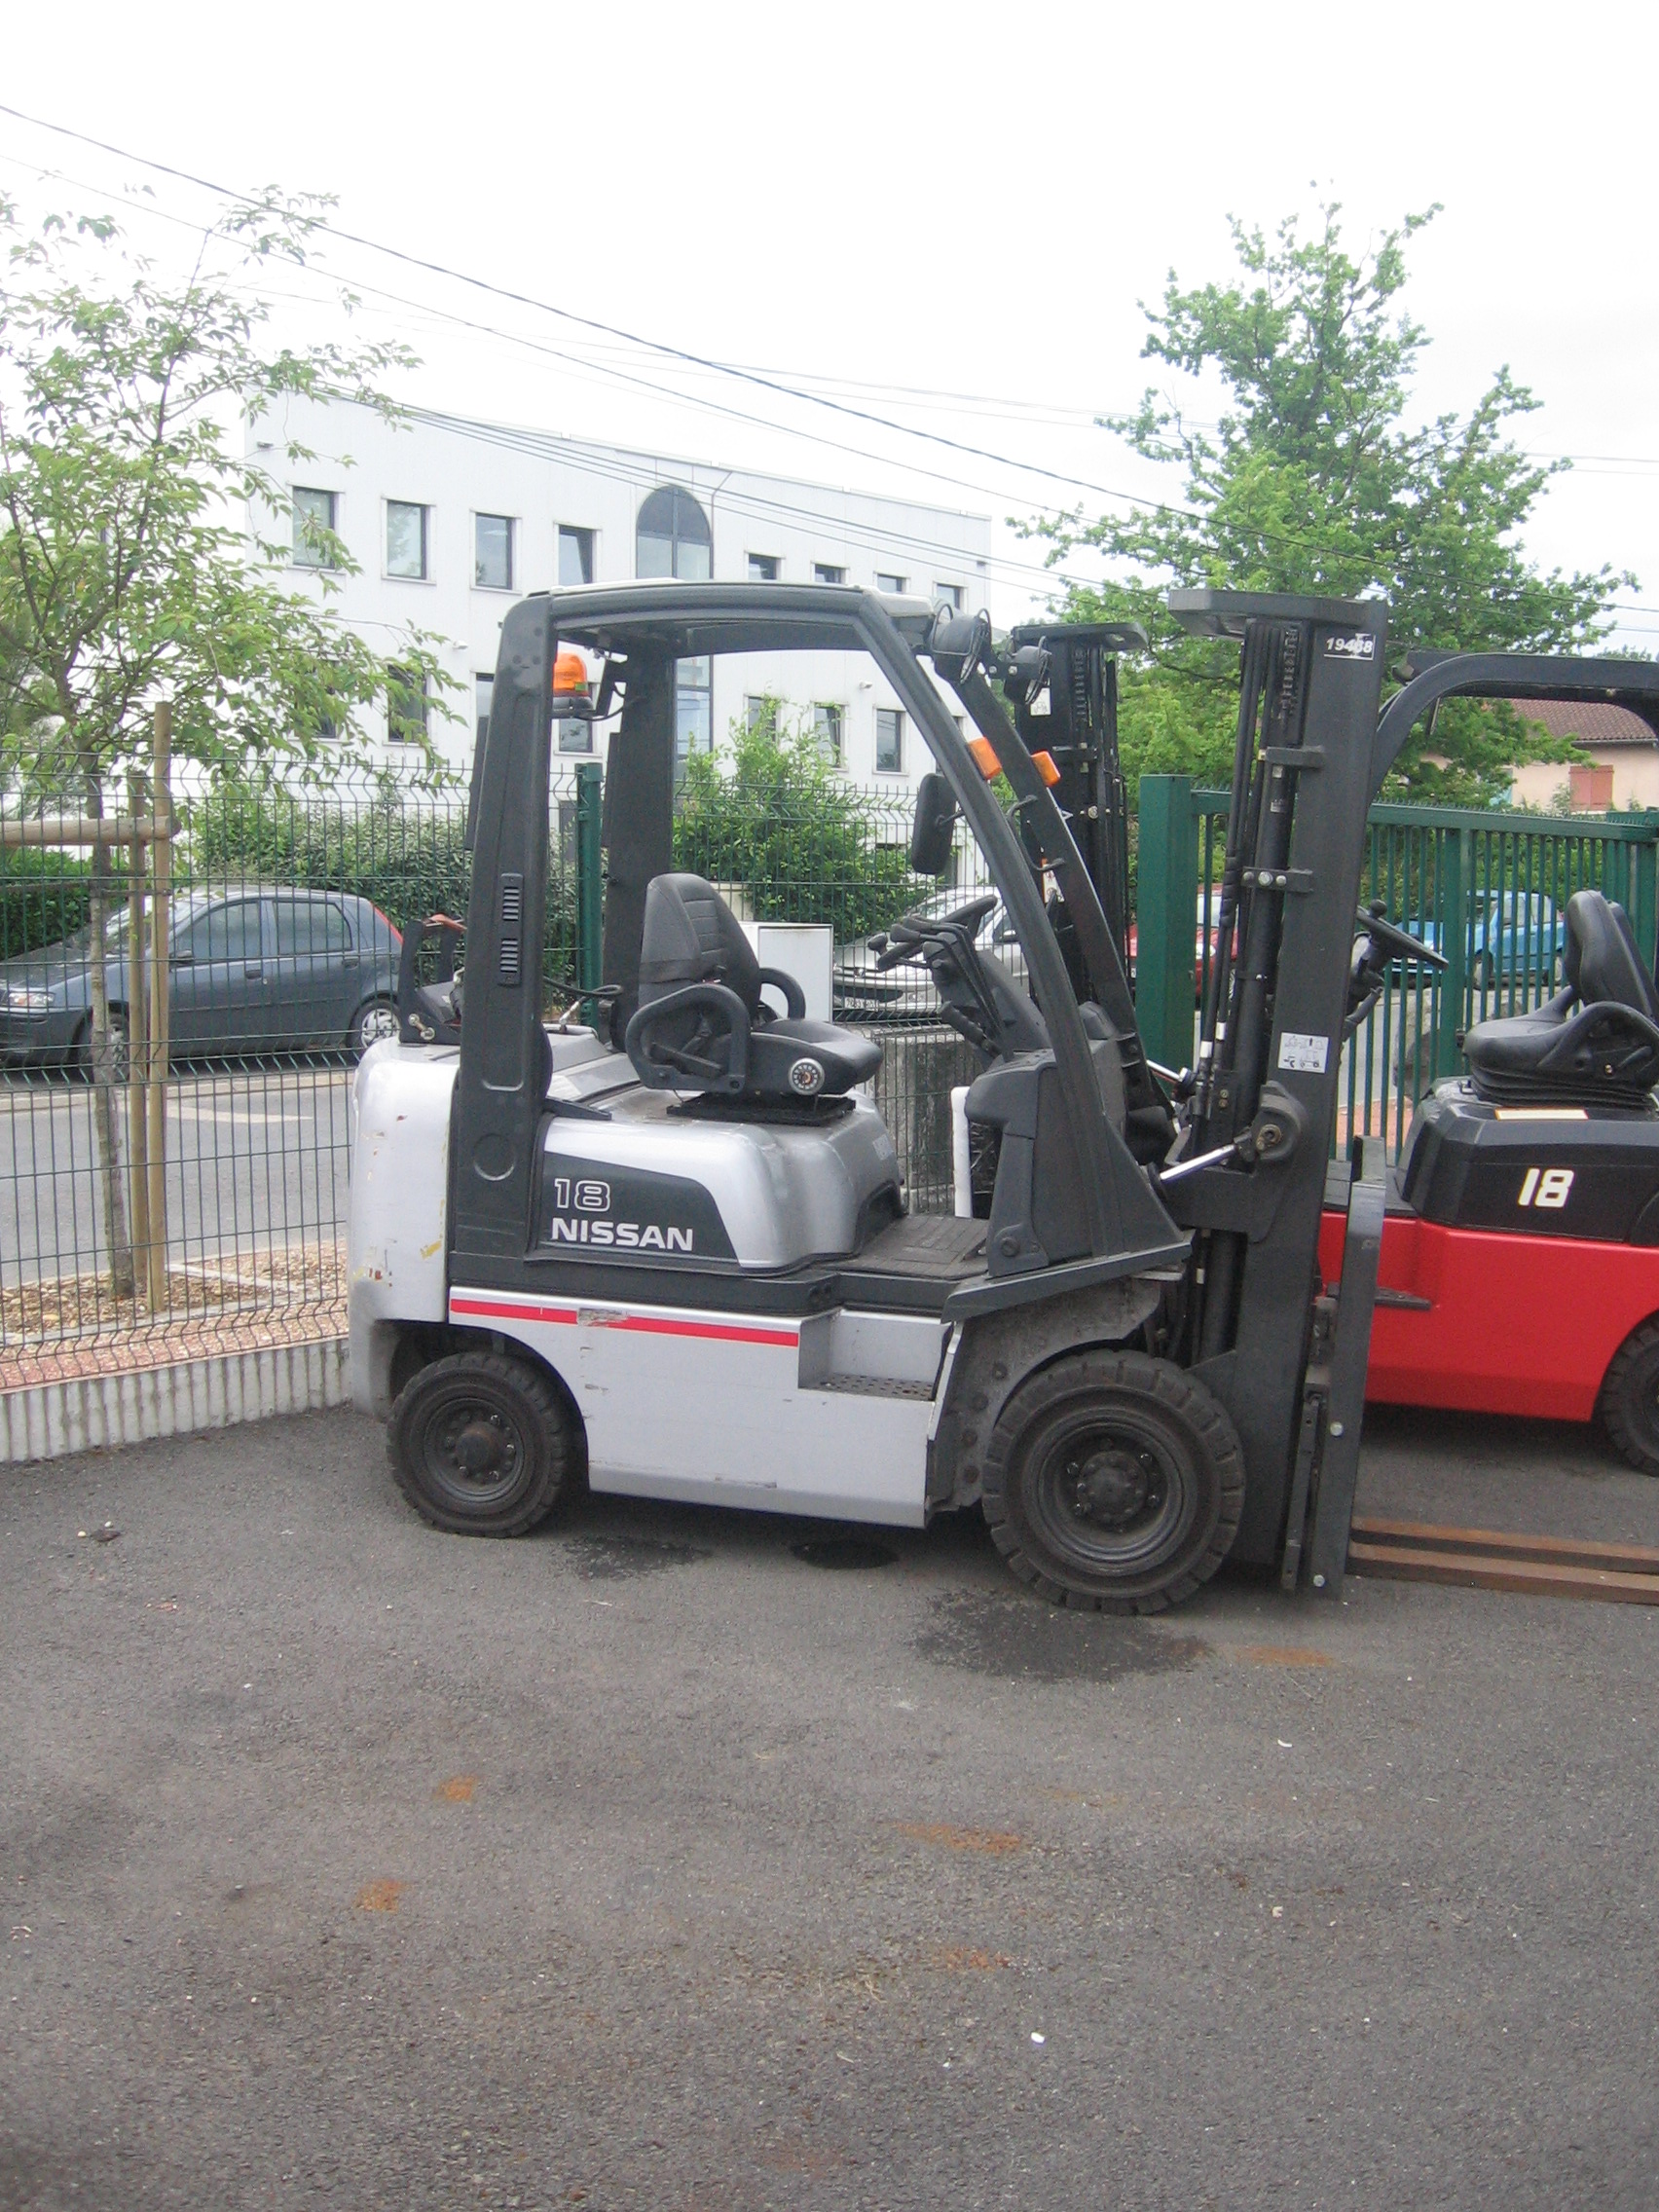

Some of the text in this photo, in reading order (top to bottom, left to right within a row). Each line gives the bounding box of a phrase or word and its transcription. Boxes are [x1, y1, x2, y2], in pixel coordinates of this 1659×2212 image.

[554, 1178, 610, 1212] 18
[1519, 1168, 1574, 1207] 18
[552, 1218, 693, 1251] NISSAN
